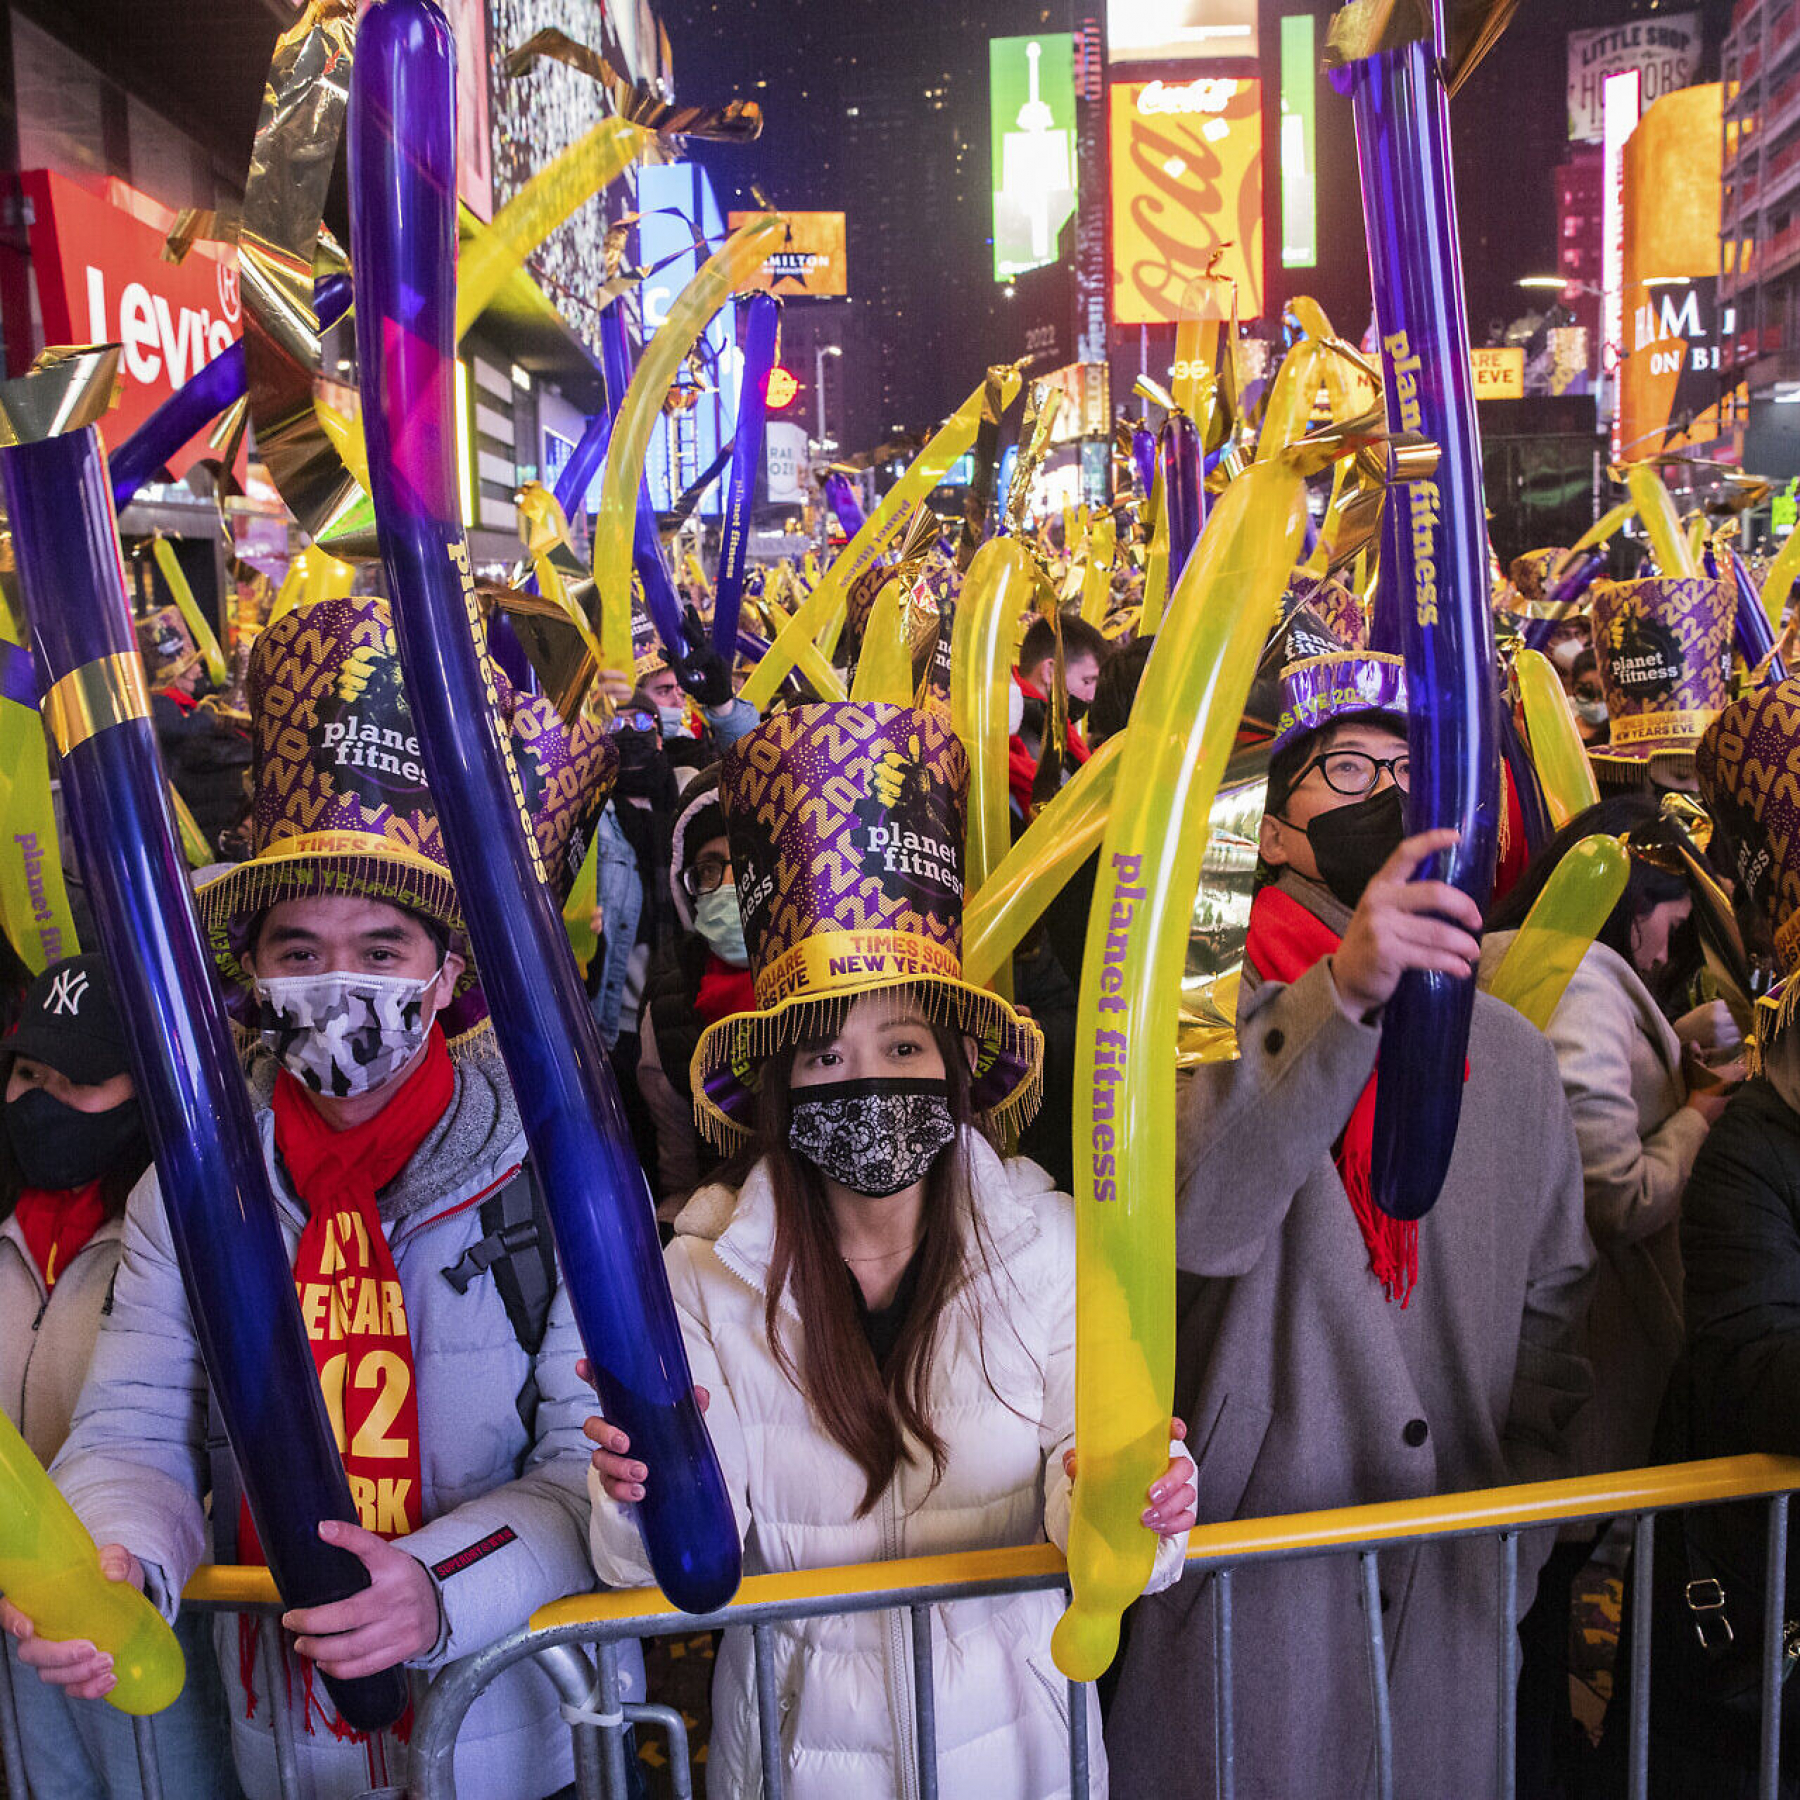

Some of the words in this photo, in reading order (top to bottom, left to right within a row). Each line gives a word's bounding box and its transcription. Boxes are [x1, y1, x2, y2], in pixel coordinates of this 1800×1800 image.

[1582, 26, 1641, 66] LITTLE
[1647, 26, 1690, 51] SHOP
[763, 255, 830, 267] MILTON
[1384, 330, 1421, 434] plan
[1478, 369, 1513, 384] EVE
[1650, 349, 1680, 376] ON
[1612, 652, 1664, 675] planet
[1619, 665, 1679, 685] fitness
[321, 716, 421, 756] plane
[1672, 723, 1695, 734] EVE
[335, 741, 429, 788] fitne
[868, 821, 958, 870] planet
[14, 832, 53, 922] planet
[1098, 853, 1147, 1014] planet
[829, 955, 887, 976] NEW
[850, 935, 918, 958] TIMES
[923, 944, 962, 981] SQUA
[779, 967, 810, 1001] EVE
[1092, 1029, 1128, 1203] fitness
[349, 1473, 412, 1535] RK
